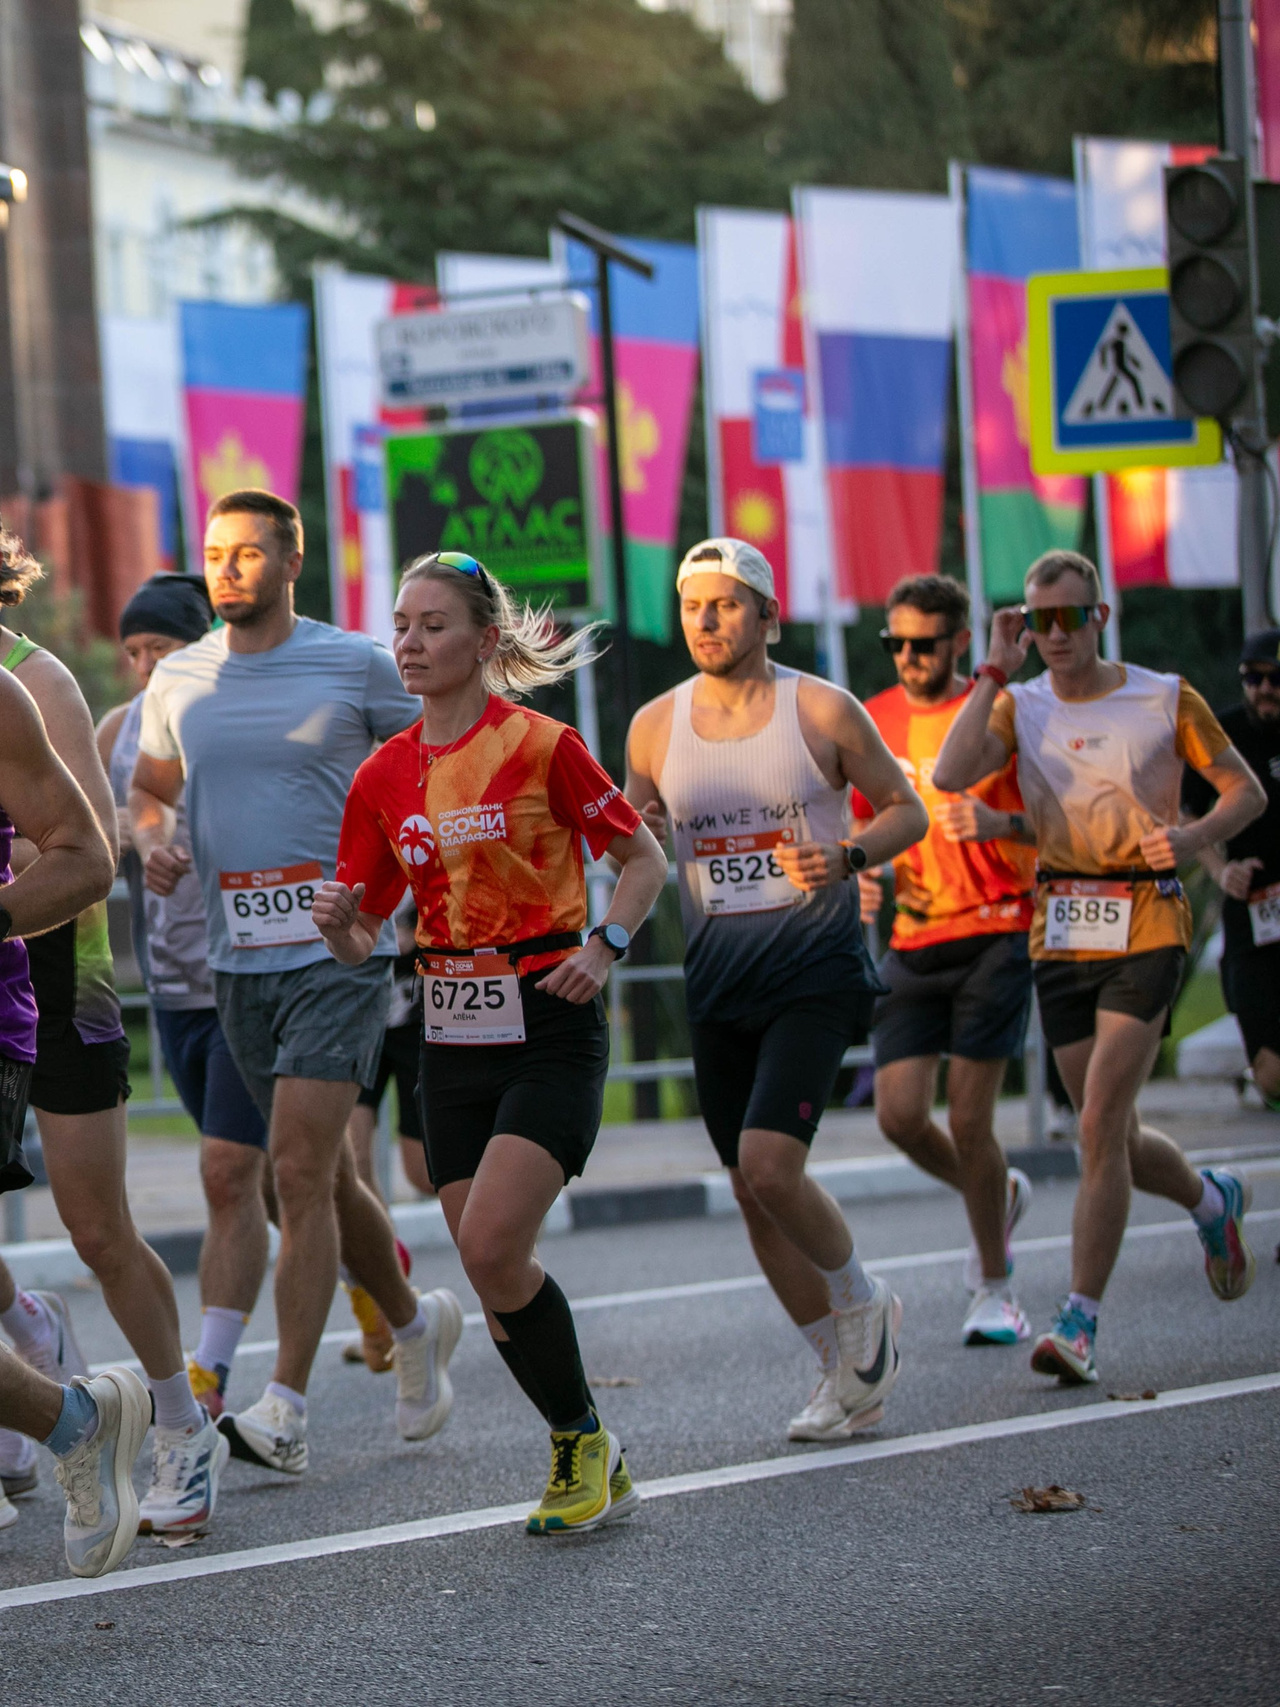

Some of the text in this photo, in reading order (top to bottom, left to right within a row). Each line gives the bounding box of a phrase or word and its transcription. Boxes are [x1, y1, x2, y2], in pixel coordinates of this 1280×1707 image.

[438, 803, 504, 820] СОВКОМБАНК
[722, 808, 752, 825] WE
[759, 802, 809, 821] TRUST
[438, 812, 506, 837] СОЧИ
[441, 829, 507, 848] МАРАФОН
[709, 855, 785, 884] 6528
[234, 885, 314, 918] 6308
[1055, 900, 1119, 924] 6585
[432, 980, 505, 1010] 6725
